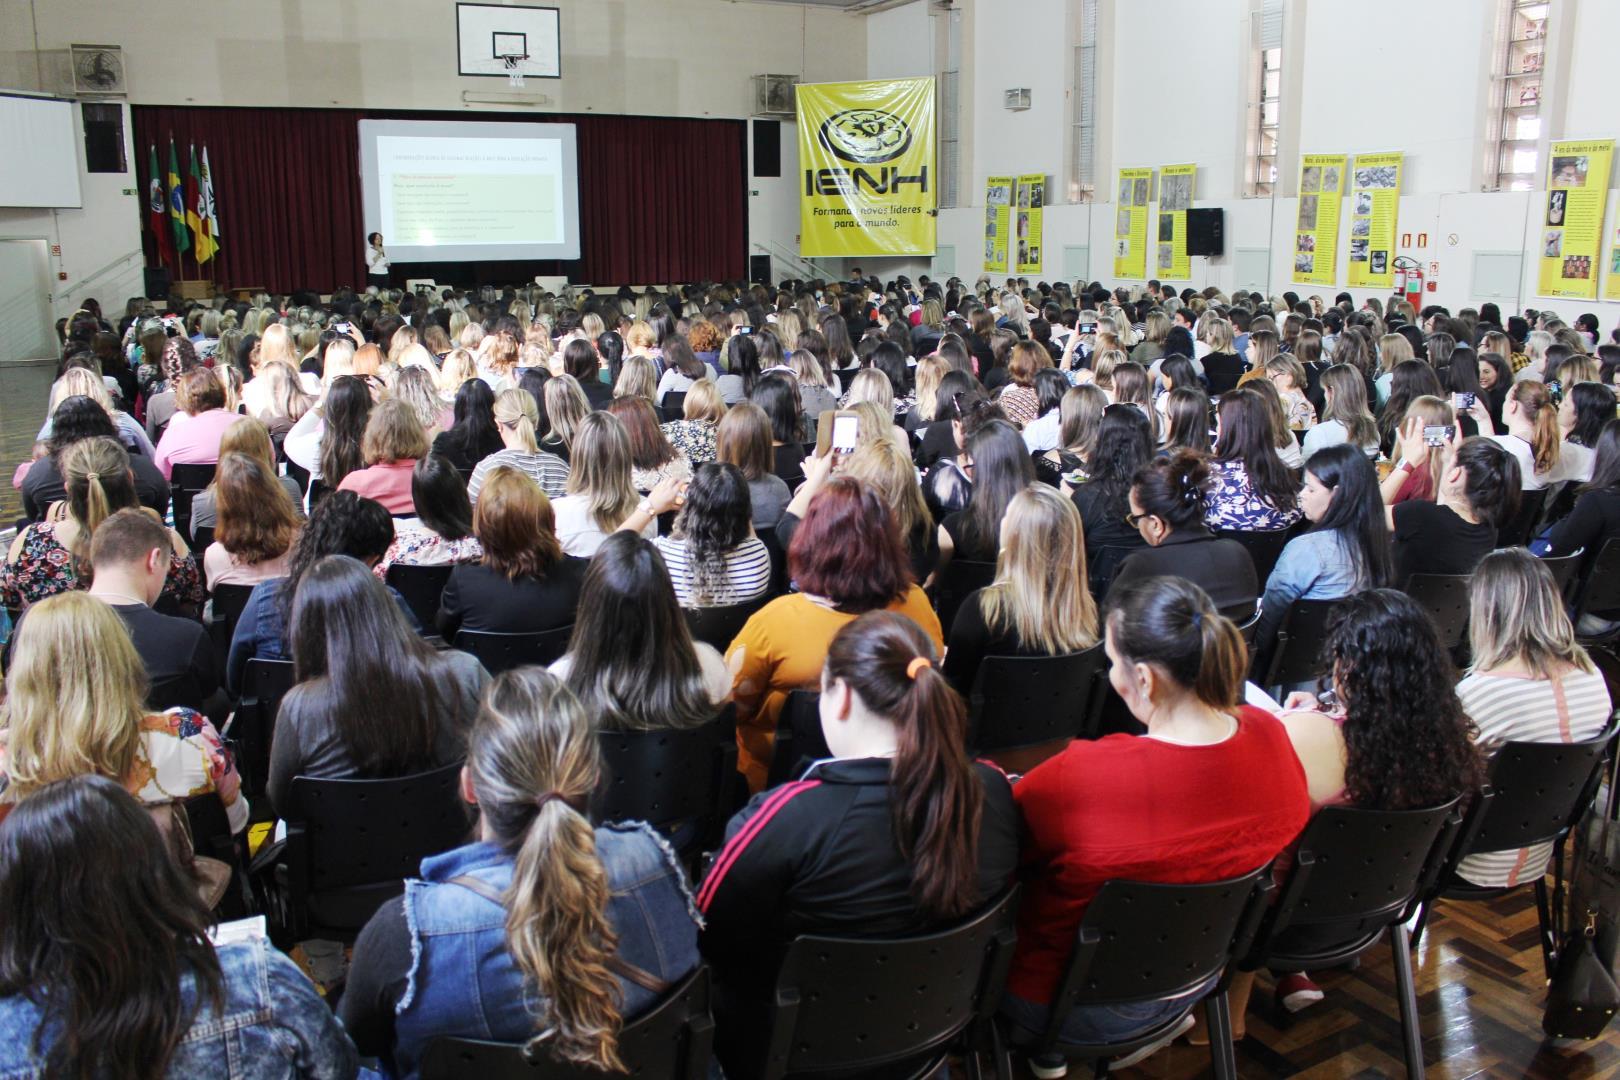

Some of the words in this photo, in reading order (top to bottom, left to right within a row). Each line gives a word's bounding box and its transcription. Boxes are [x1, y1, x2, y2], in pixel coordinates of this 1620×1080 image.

[806, 166, 928, 196] IENH
[813, 207, 857, 216] Formand
[860, 206, 888, 215] novos
[834, 219, 854, 230] para
[865, 217, 900, 228] mundo.
